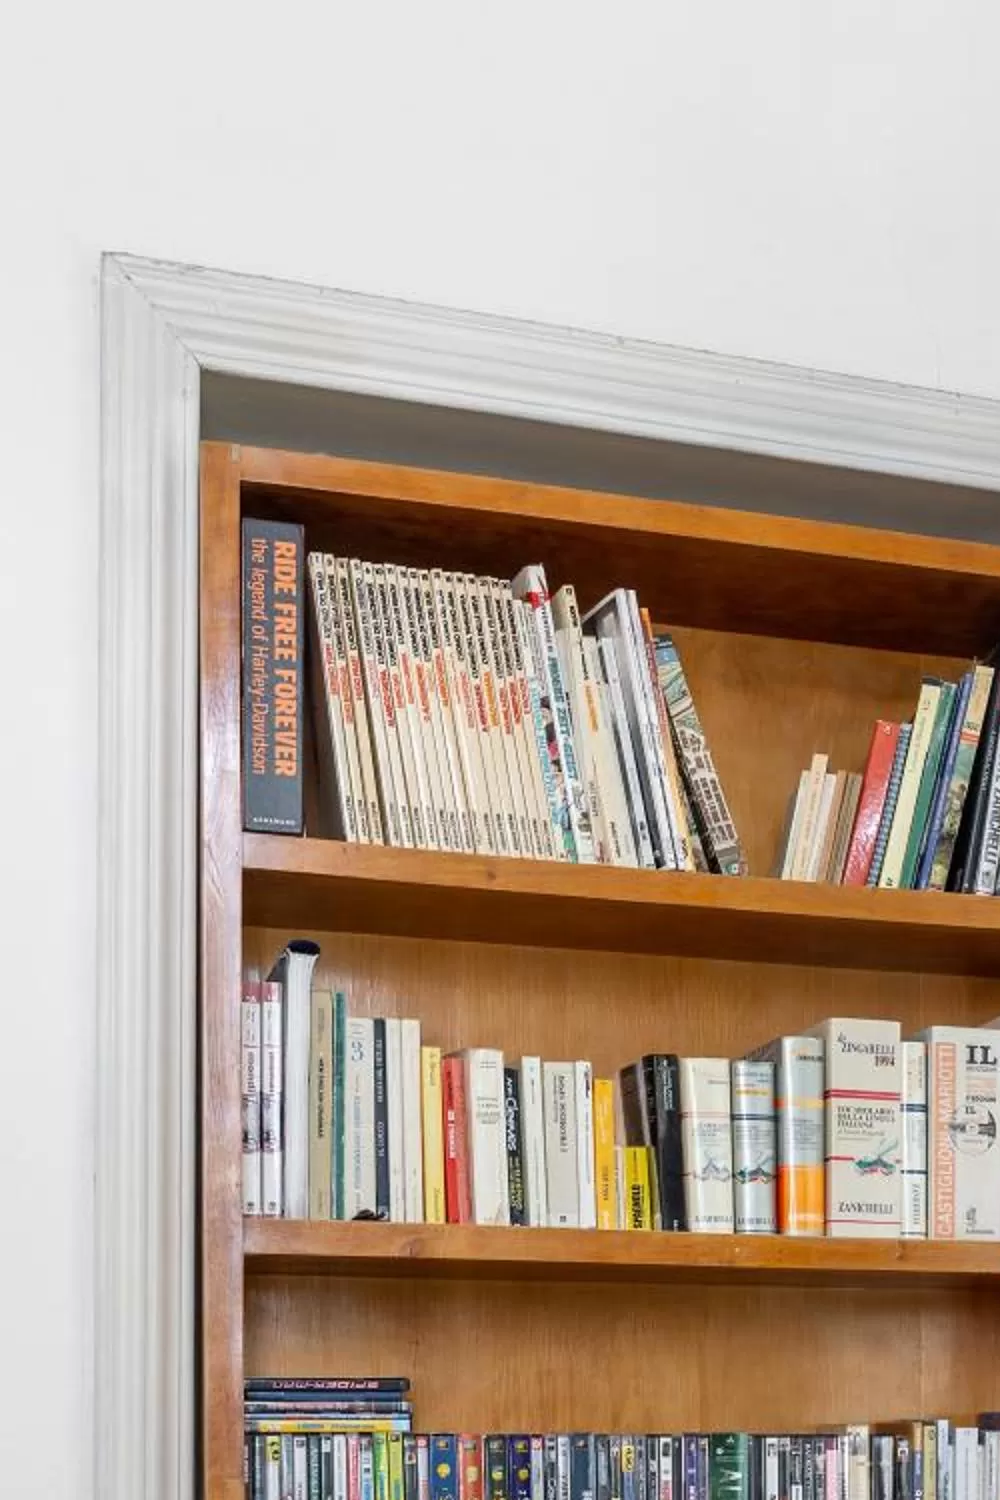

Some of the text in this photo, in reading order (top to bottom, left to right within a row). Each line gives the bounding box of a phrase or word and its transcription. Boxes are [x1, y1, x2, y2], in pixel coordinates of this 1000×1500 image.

[248, 538, 269, 776] the legend of Harley-Davidson
[273, 542, 297, 777] RIDE FREE FOREVER
[875, 1056, 895, 1067] 1994
[965, 1045, 997, 1065] IL
[838, 1202, 893, 1214] ZANICHELLI
